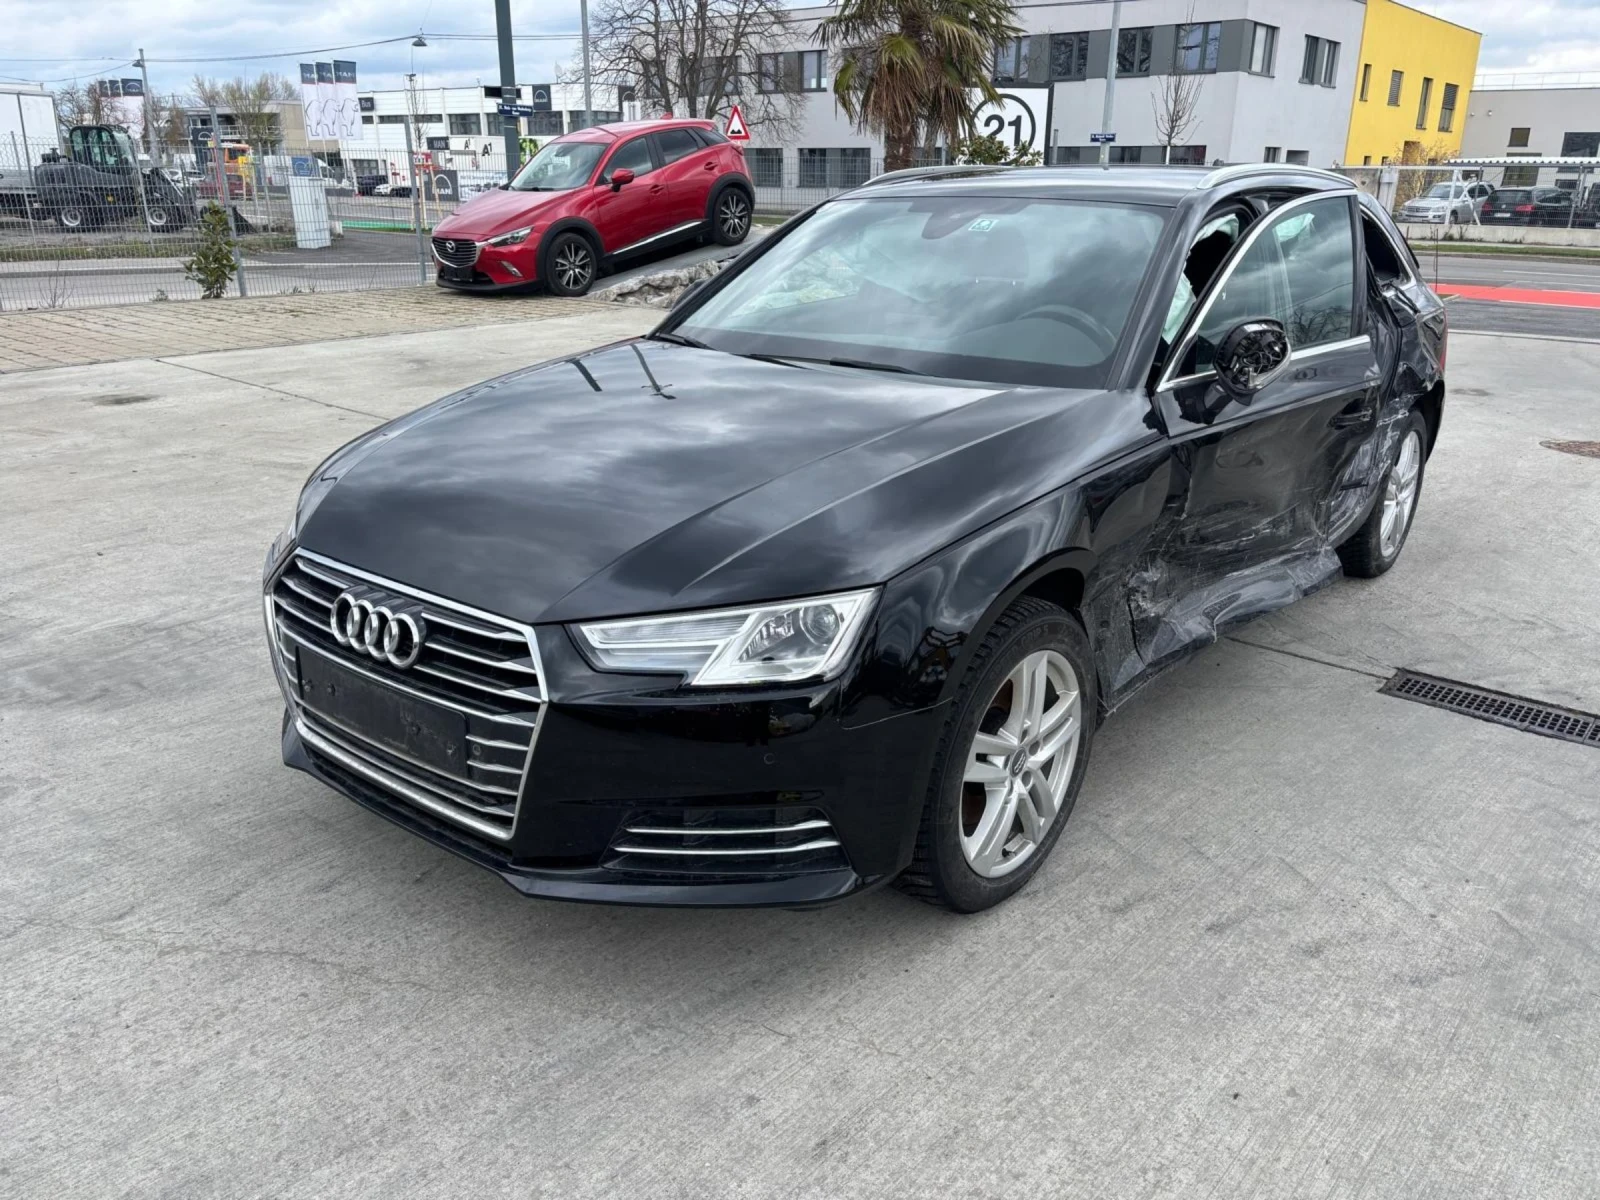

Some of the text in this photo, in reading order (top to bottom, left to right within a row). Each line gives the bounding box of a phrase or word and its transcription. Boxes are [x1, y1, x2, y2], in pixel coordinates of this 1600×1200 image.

[983, 113, 1022, 147] 21
[433, 139, 446, 149] MAN
[464, 138, 471, 150] A1
[482, 142, 493, 156] A1
